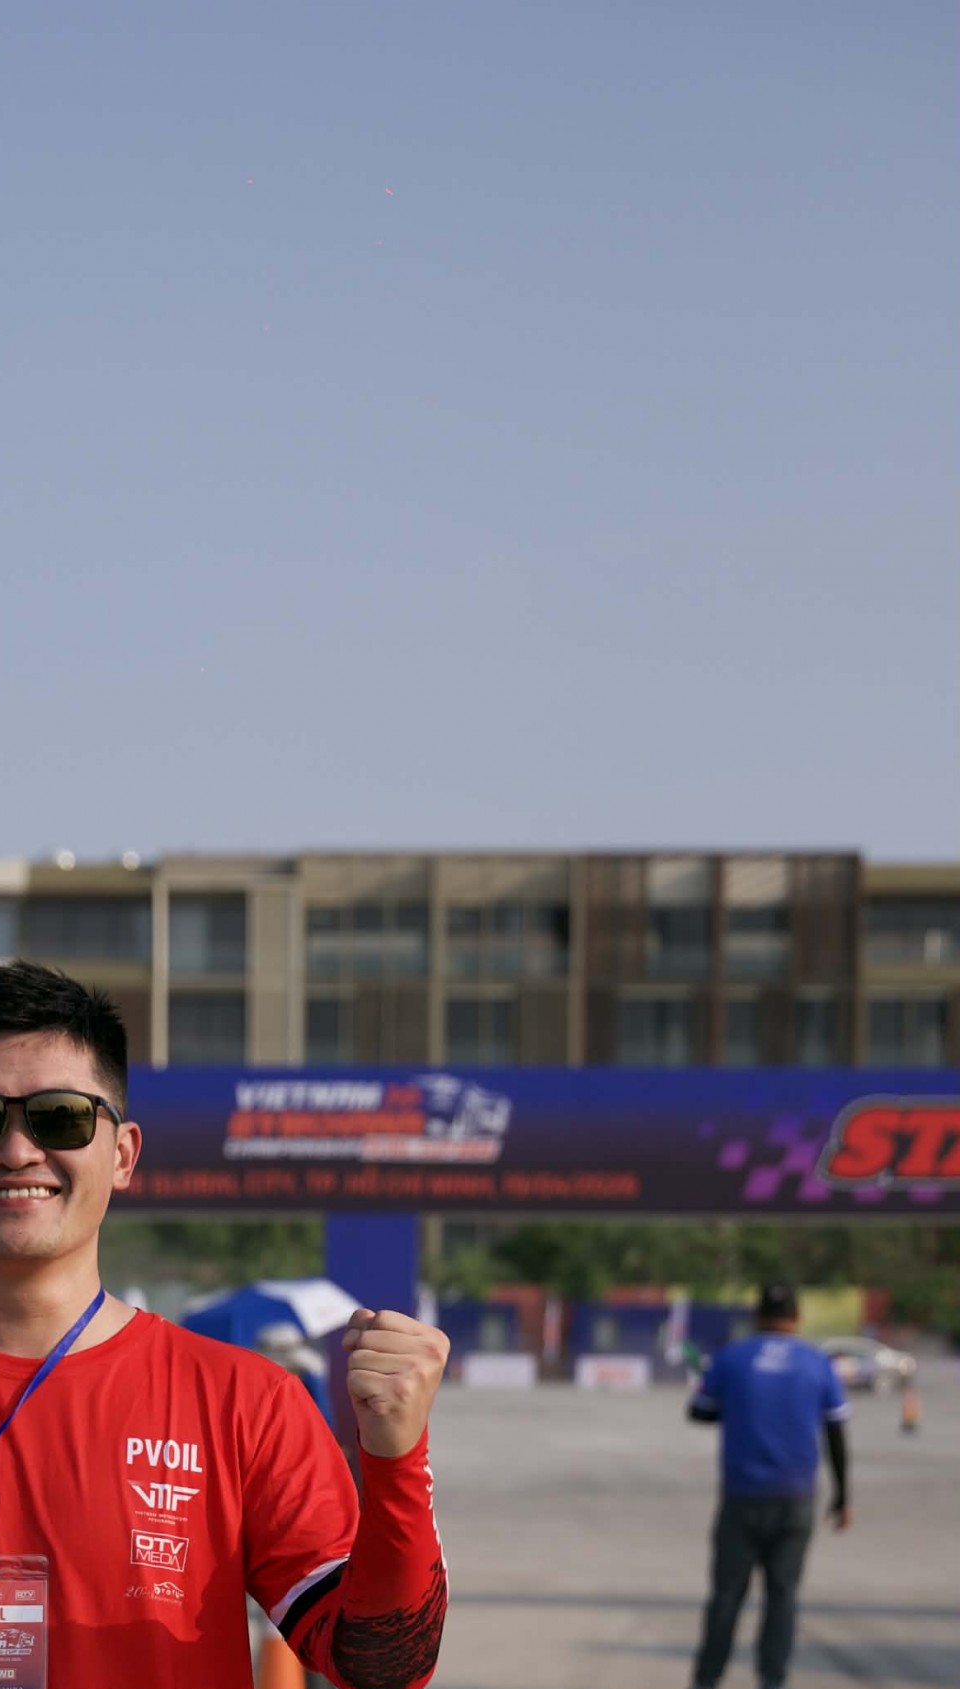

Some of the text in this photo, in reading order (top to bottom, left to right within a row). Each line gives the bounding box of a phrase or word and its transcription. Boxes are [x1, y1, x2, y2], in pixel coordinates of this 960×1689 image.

[828, 1108, 960, 1177] ST
[126, 1437, 203, 1472] PVOIL
[136, 1535, 184, 1554] OTV
[136, 1549, 181, 1571] MEDIA
